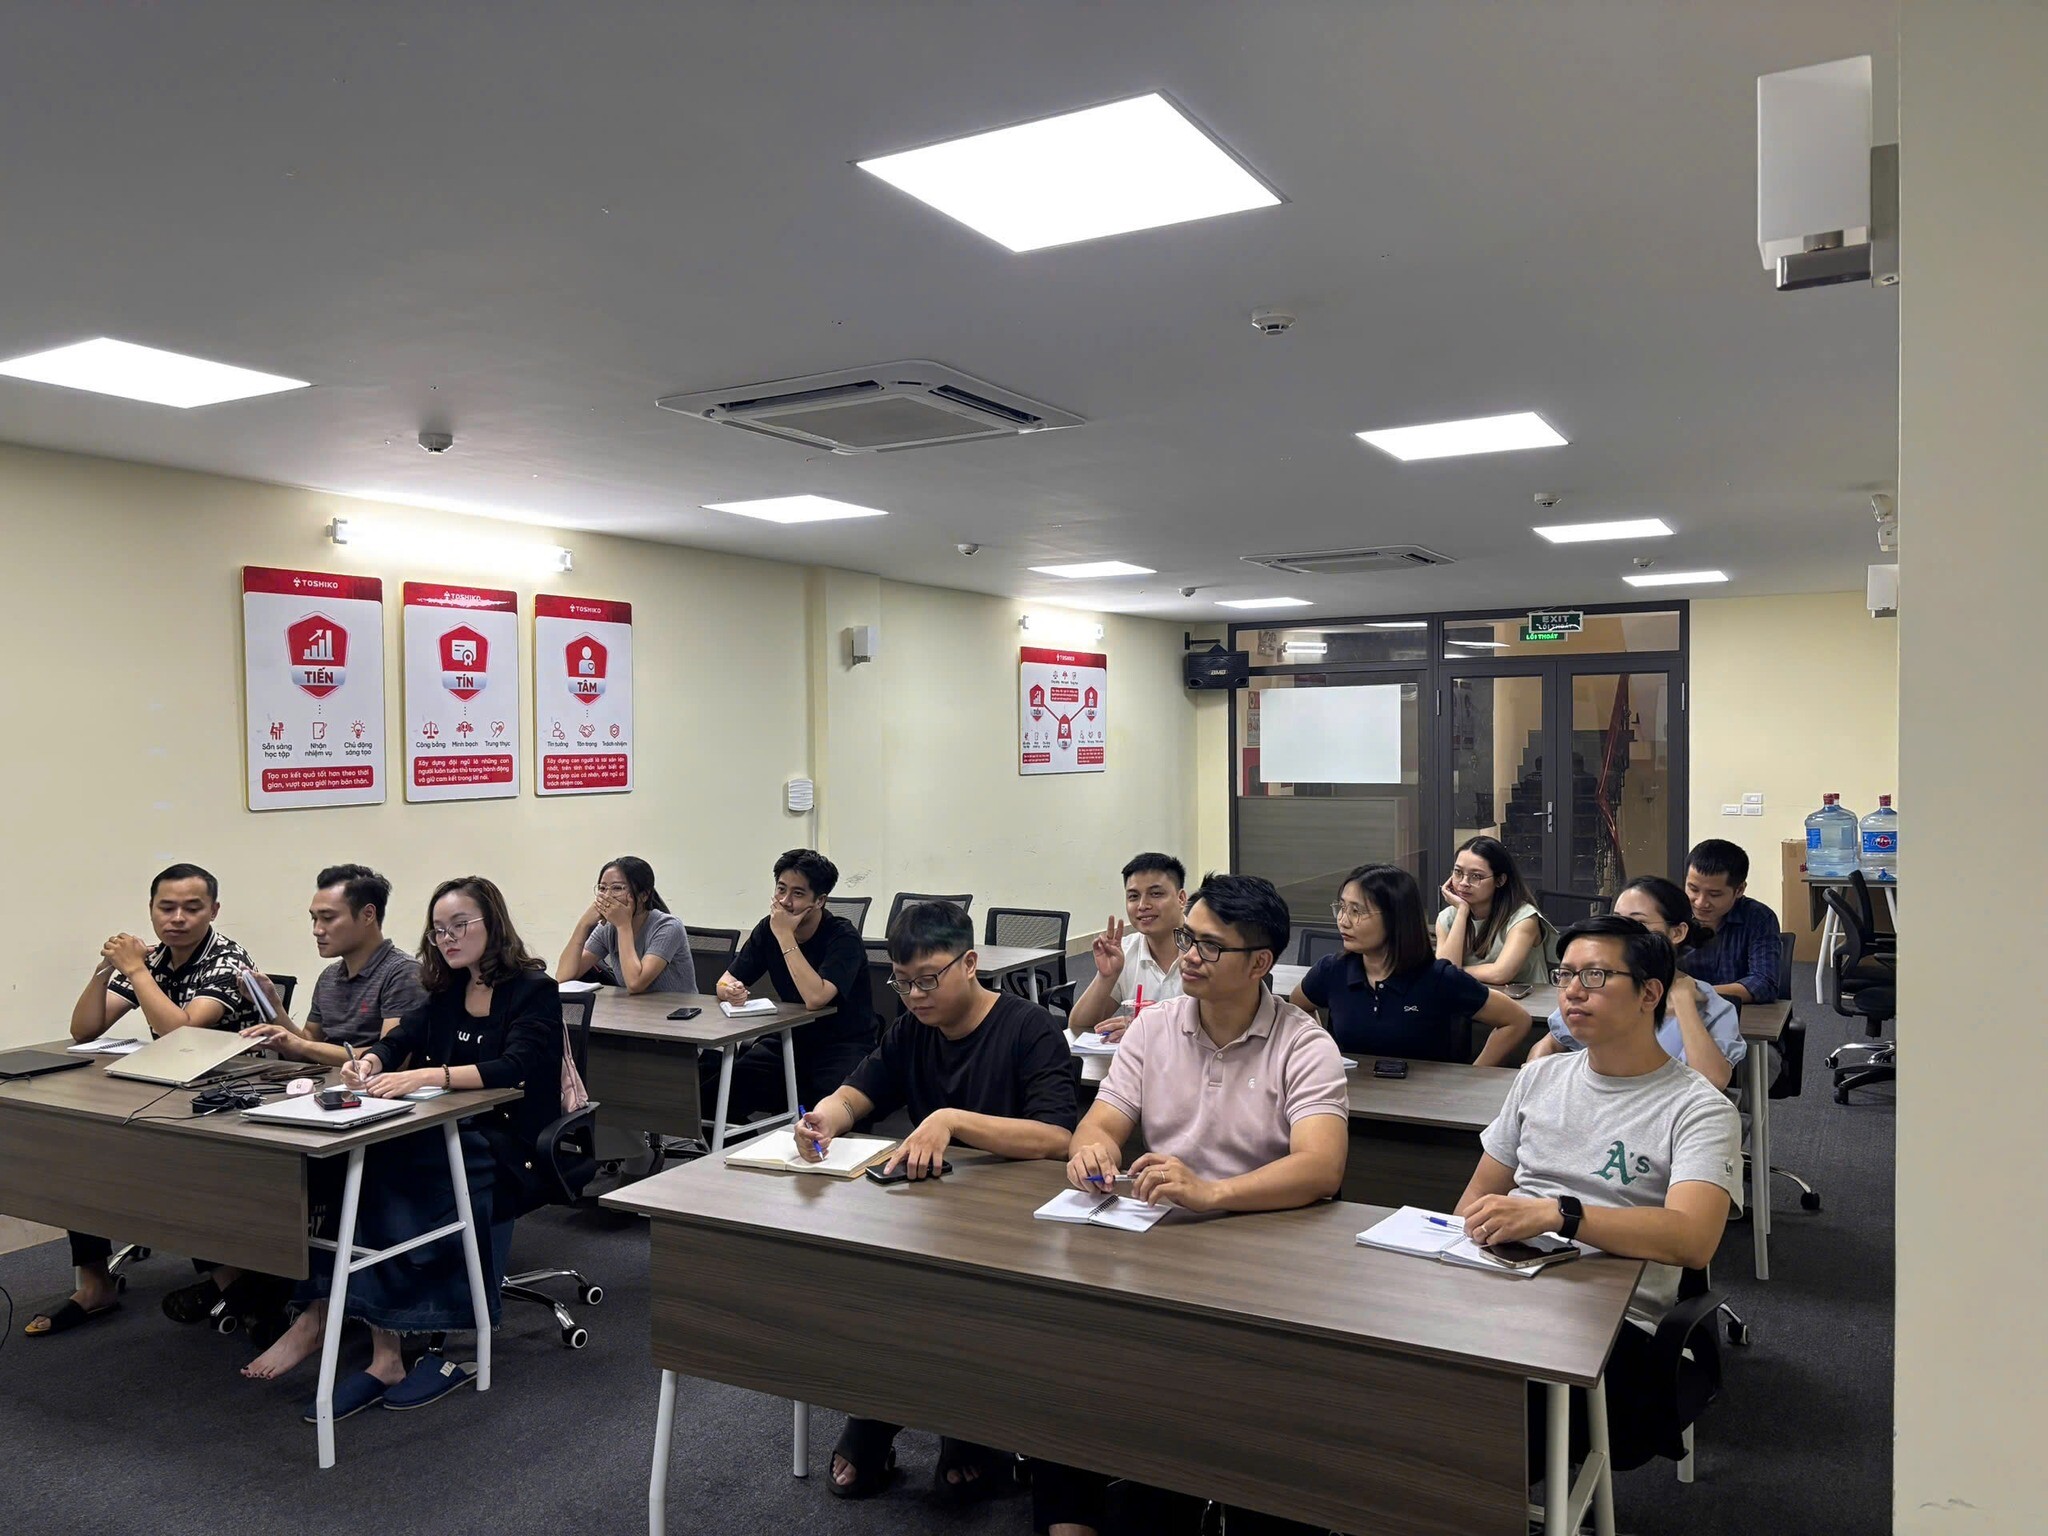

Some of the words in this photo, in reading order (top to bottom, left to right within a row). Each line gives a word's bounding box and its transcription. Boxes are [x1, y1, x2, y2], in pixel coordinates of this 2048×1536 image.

[302, 579, 338, 589] TOSHIKO
[305, 667, 334, 683] TIẾN
[456, 674, 474, 688] TÍN
[577, 679, 597, 692] TÂM
[262, 743, 275, 751] Sẵn
[265, 751, 277, 759] học
[278, 750, 290, 758] tập
